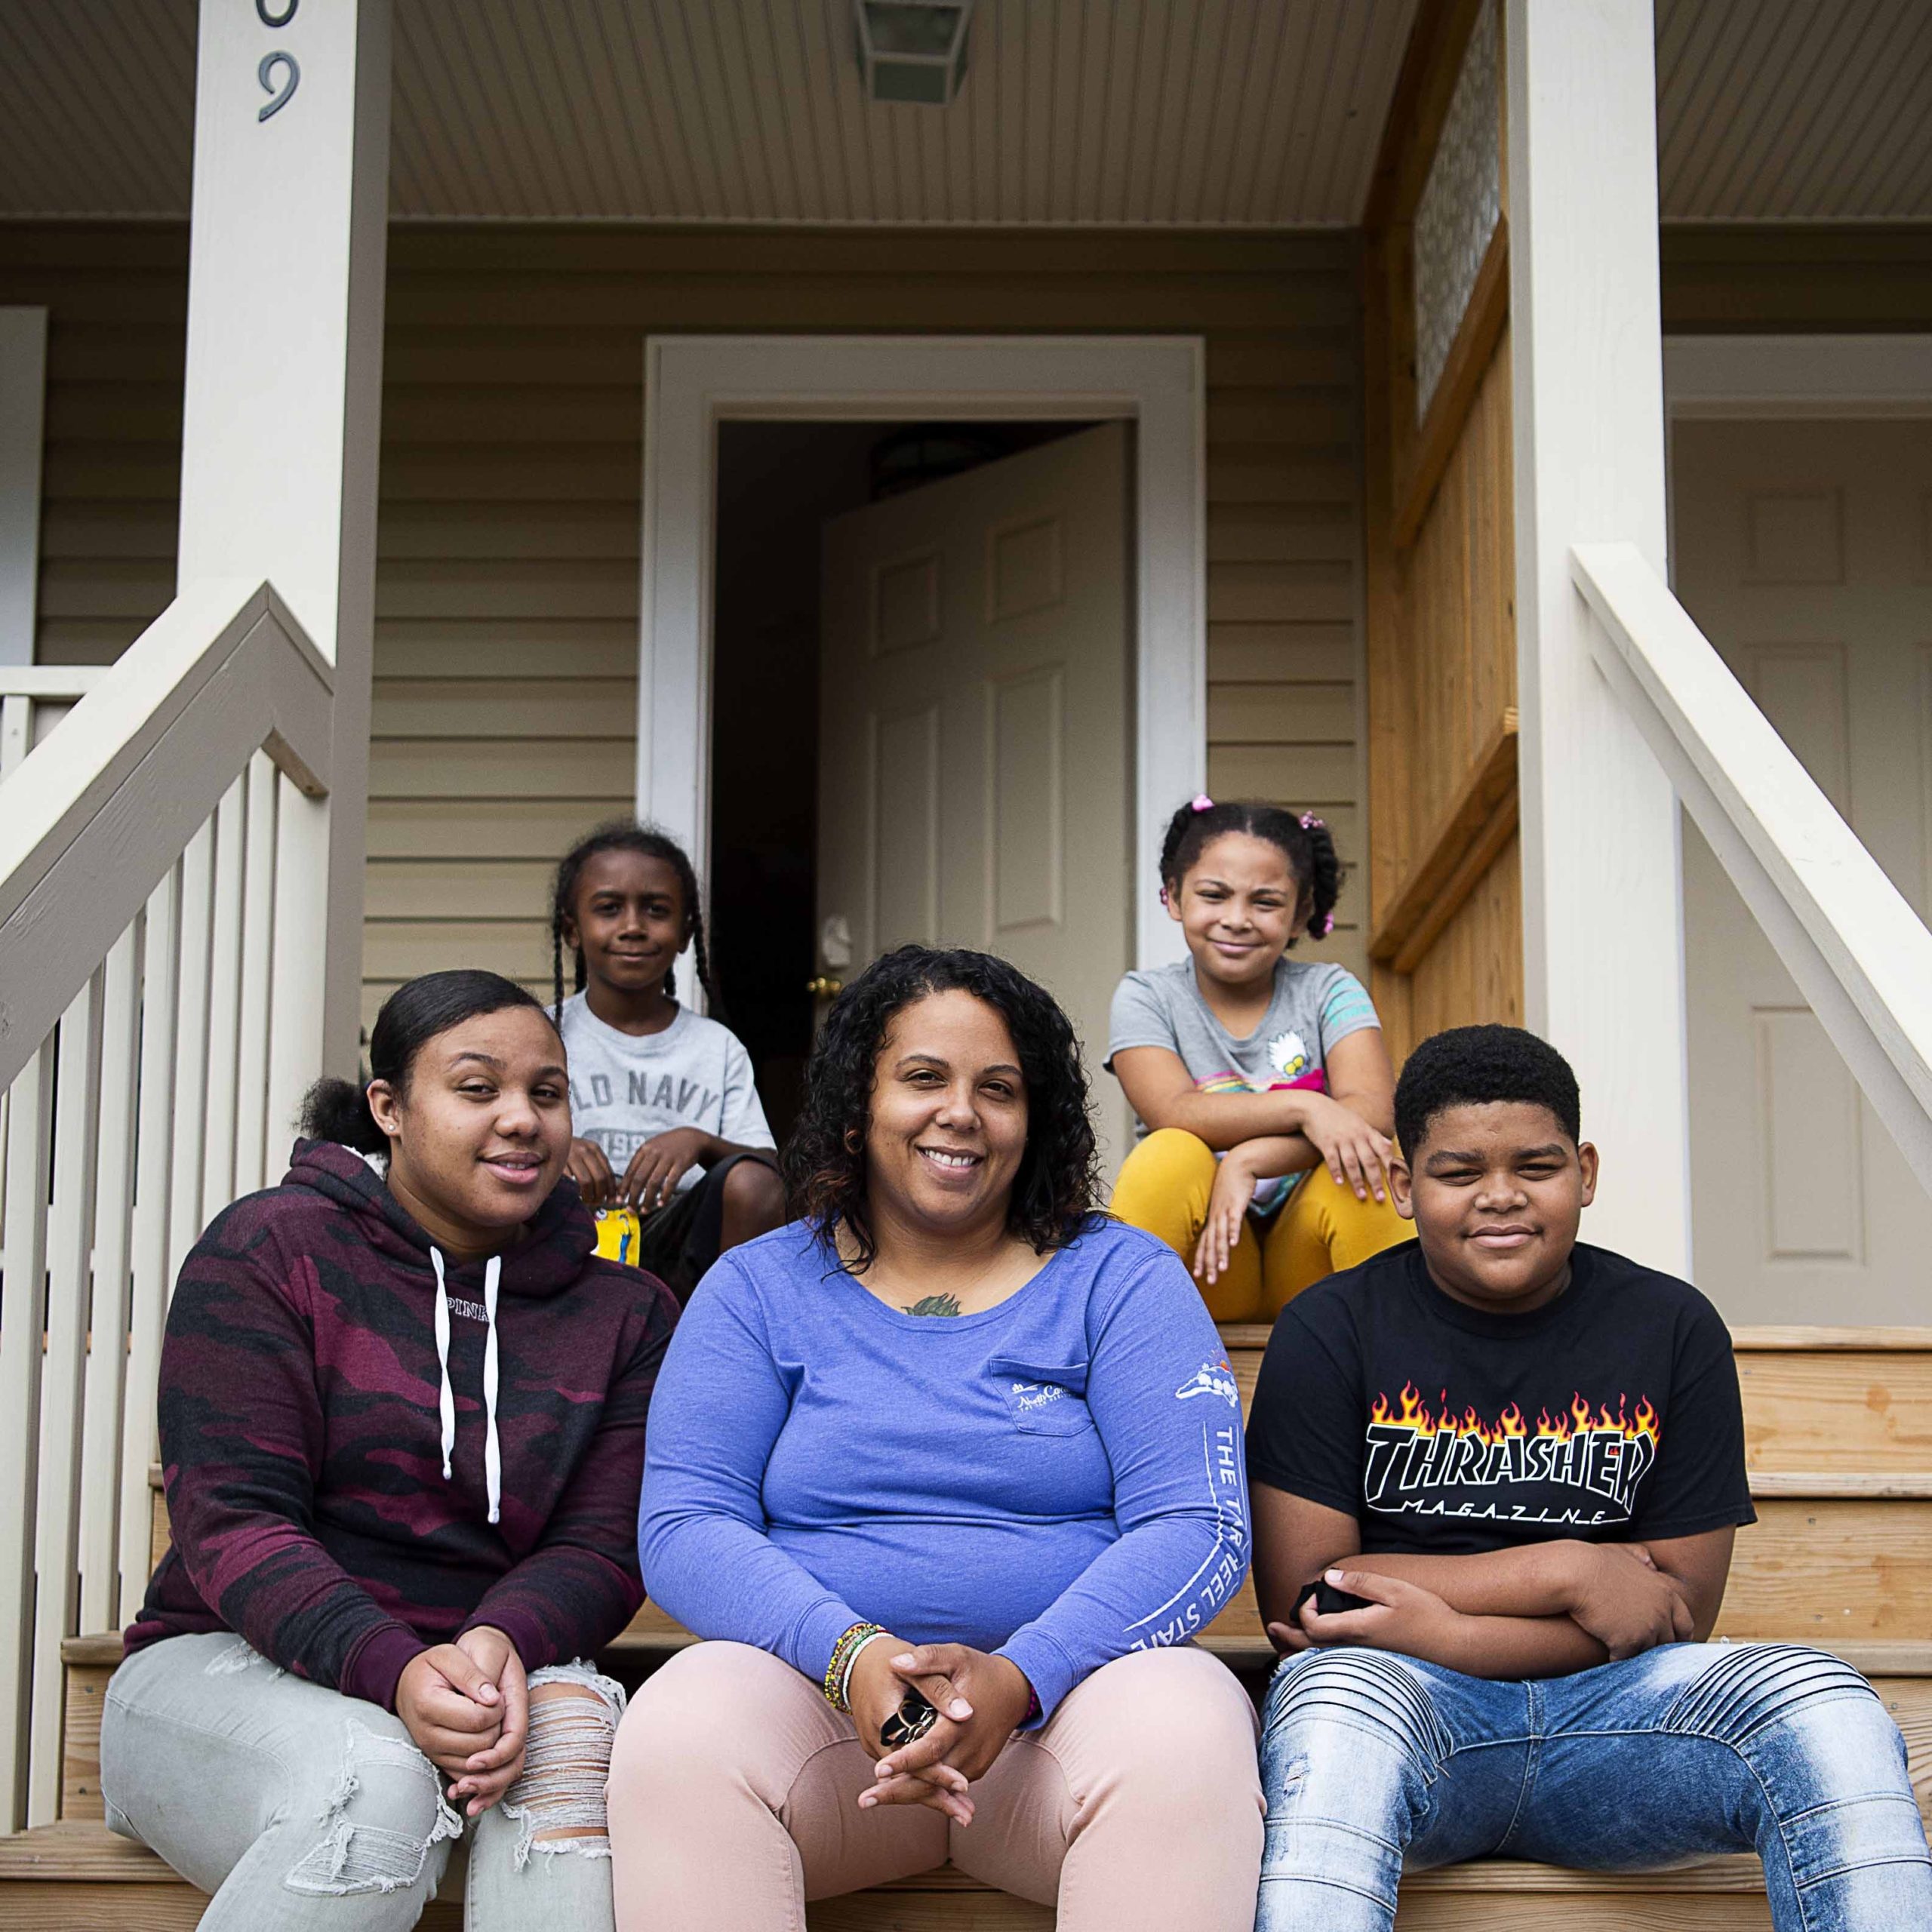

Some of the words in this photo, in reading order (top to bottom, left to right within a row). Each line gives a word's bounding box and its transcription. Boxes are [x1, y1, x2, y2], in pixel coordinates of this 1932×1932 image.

[569, 1074, 614, 1111] LD
[628, 1069, 718, 1122] NAVY
[446, 1297, 491, 1322] PINK
[1216, 1426, 1238, 1487] THE
[1364, 1422, 1656, 1516] THRASHER
[1225, 1497, 1244, 1548] TAR
[1400, 1499, 1607, 1525] MAGAZINE
